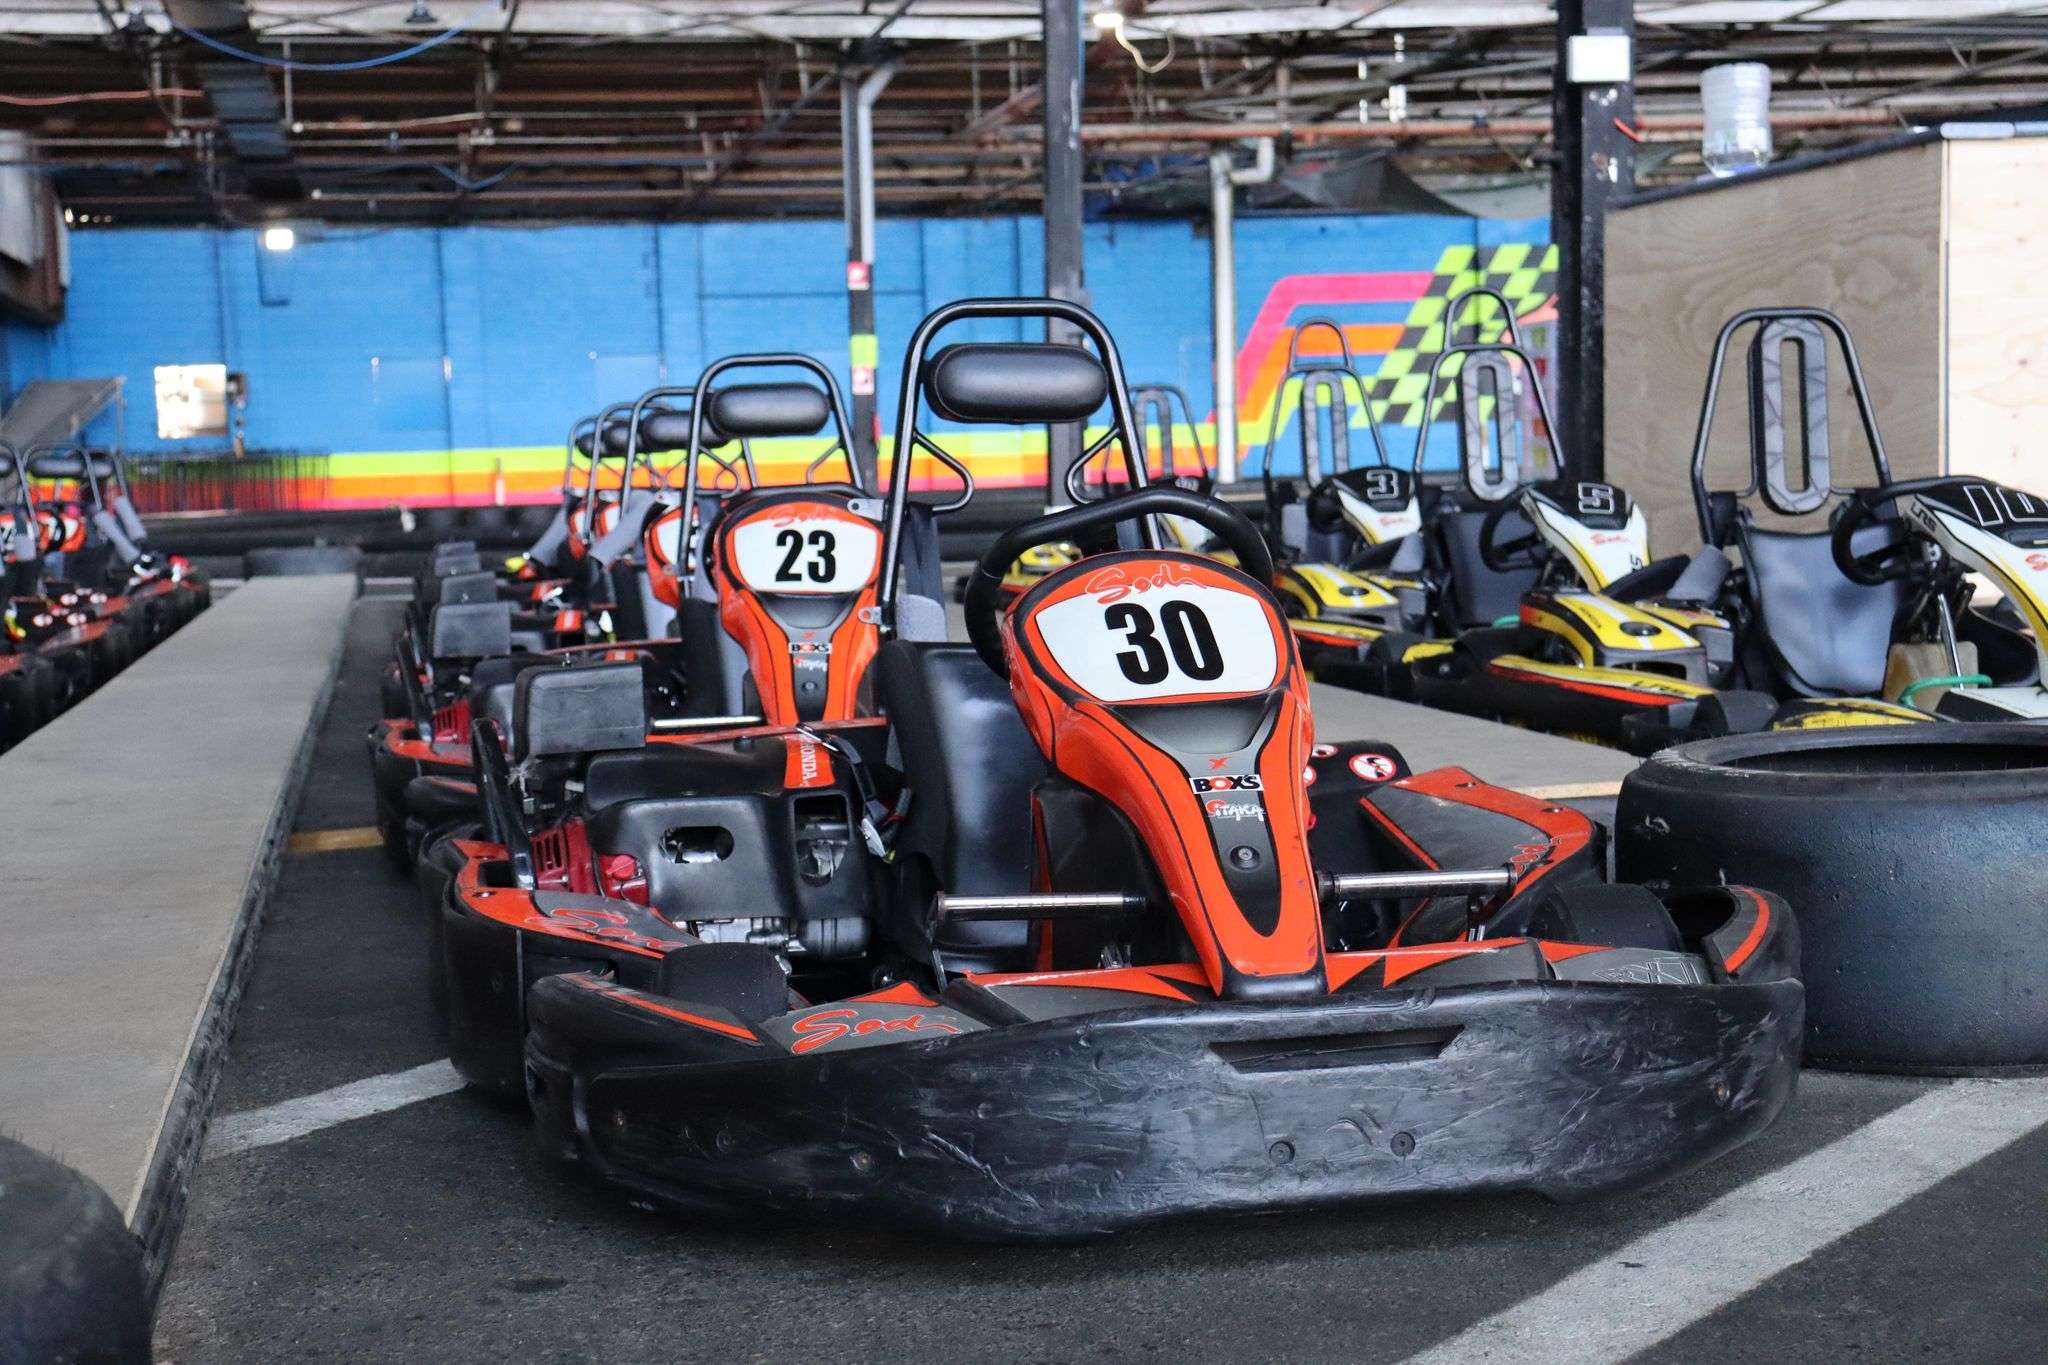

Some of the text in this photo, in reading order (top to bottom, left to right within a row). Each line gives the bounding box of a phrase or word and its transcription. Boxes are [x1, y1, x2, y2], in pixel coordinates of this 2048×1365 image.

[1367, 469, 1399, 500] 3
[1578, 482, 1615, 514] 5
[775, 529, 836, 583] 23
[1085, 563, 1207, 604] Sodi
[1104, 600, 1225, 685] 30
